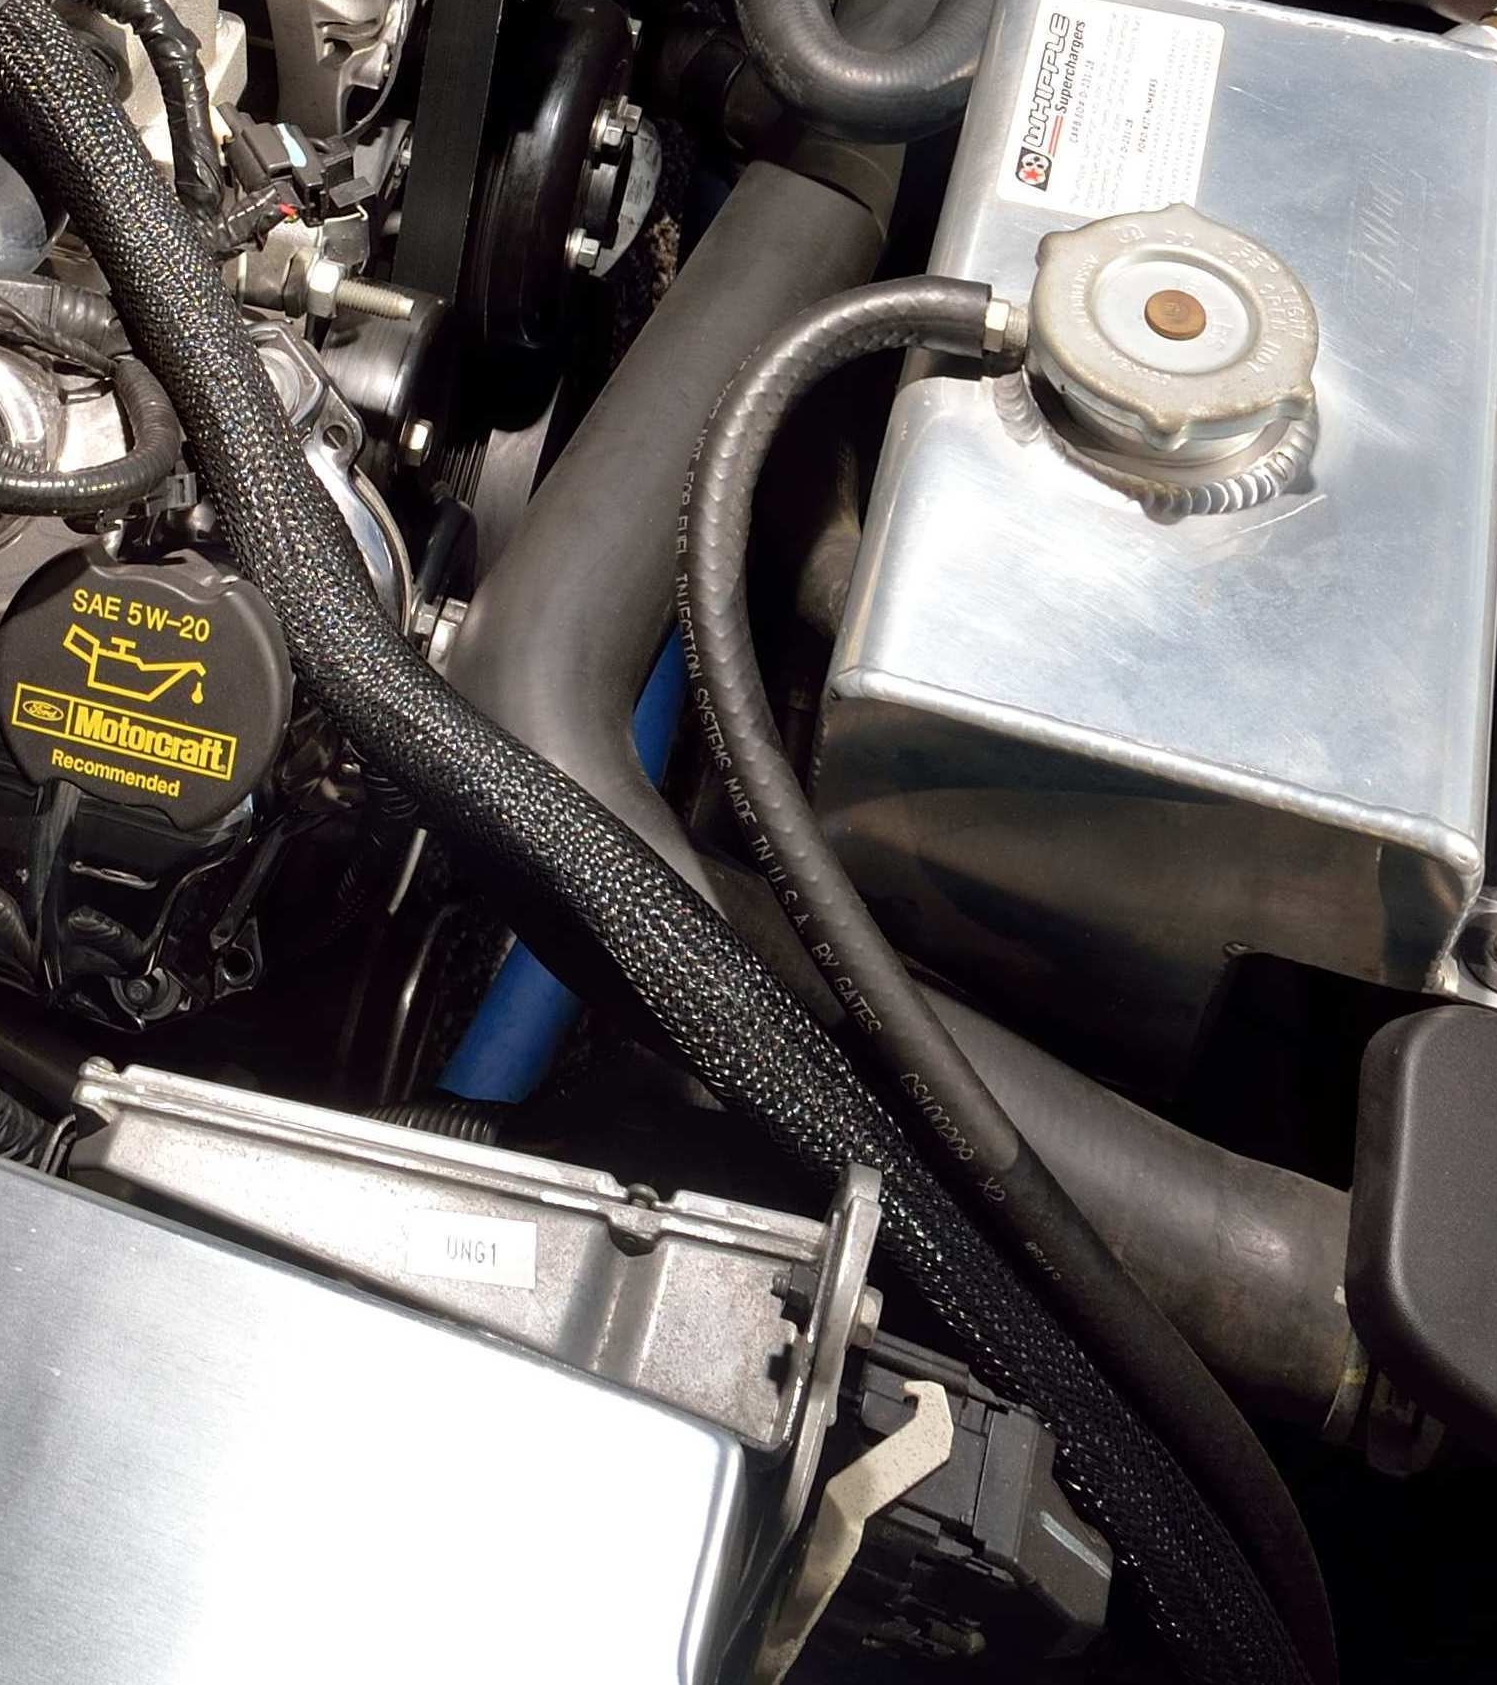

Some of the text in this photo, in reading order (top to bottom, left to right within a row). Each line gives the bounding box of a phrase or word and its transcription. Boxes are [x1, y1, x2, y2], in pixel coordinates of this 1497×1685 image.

[1022, 12, 1070, 148] WHIPPLE
[1055, 20, 1086, 115] Superchargers
[72, 588, 211, 643] SAE 5W-20
[51, 747, 181, 797] Recommended
[73, 705, 224, 772] Motorcraft
[694, 686, 733, 788] SYSTEMS
[723, 777, 759, 835] MADE
[811, 942, 840, 968] BY
[835, 976, 883, 1034] GATES
